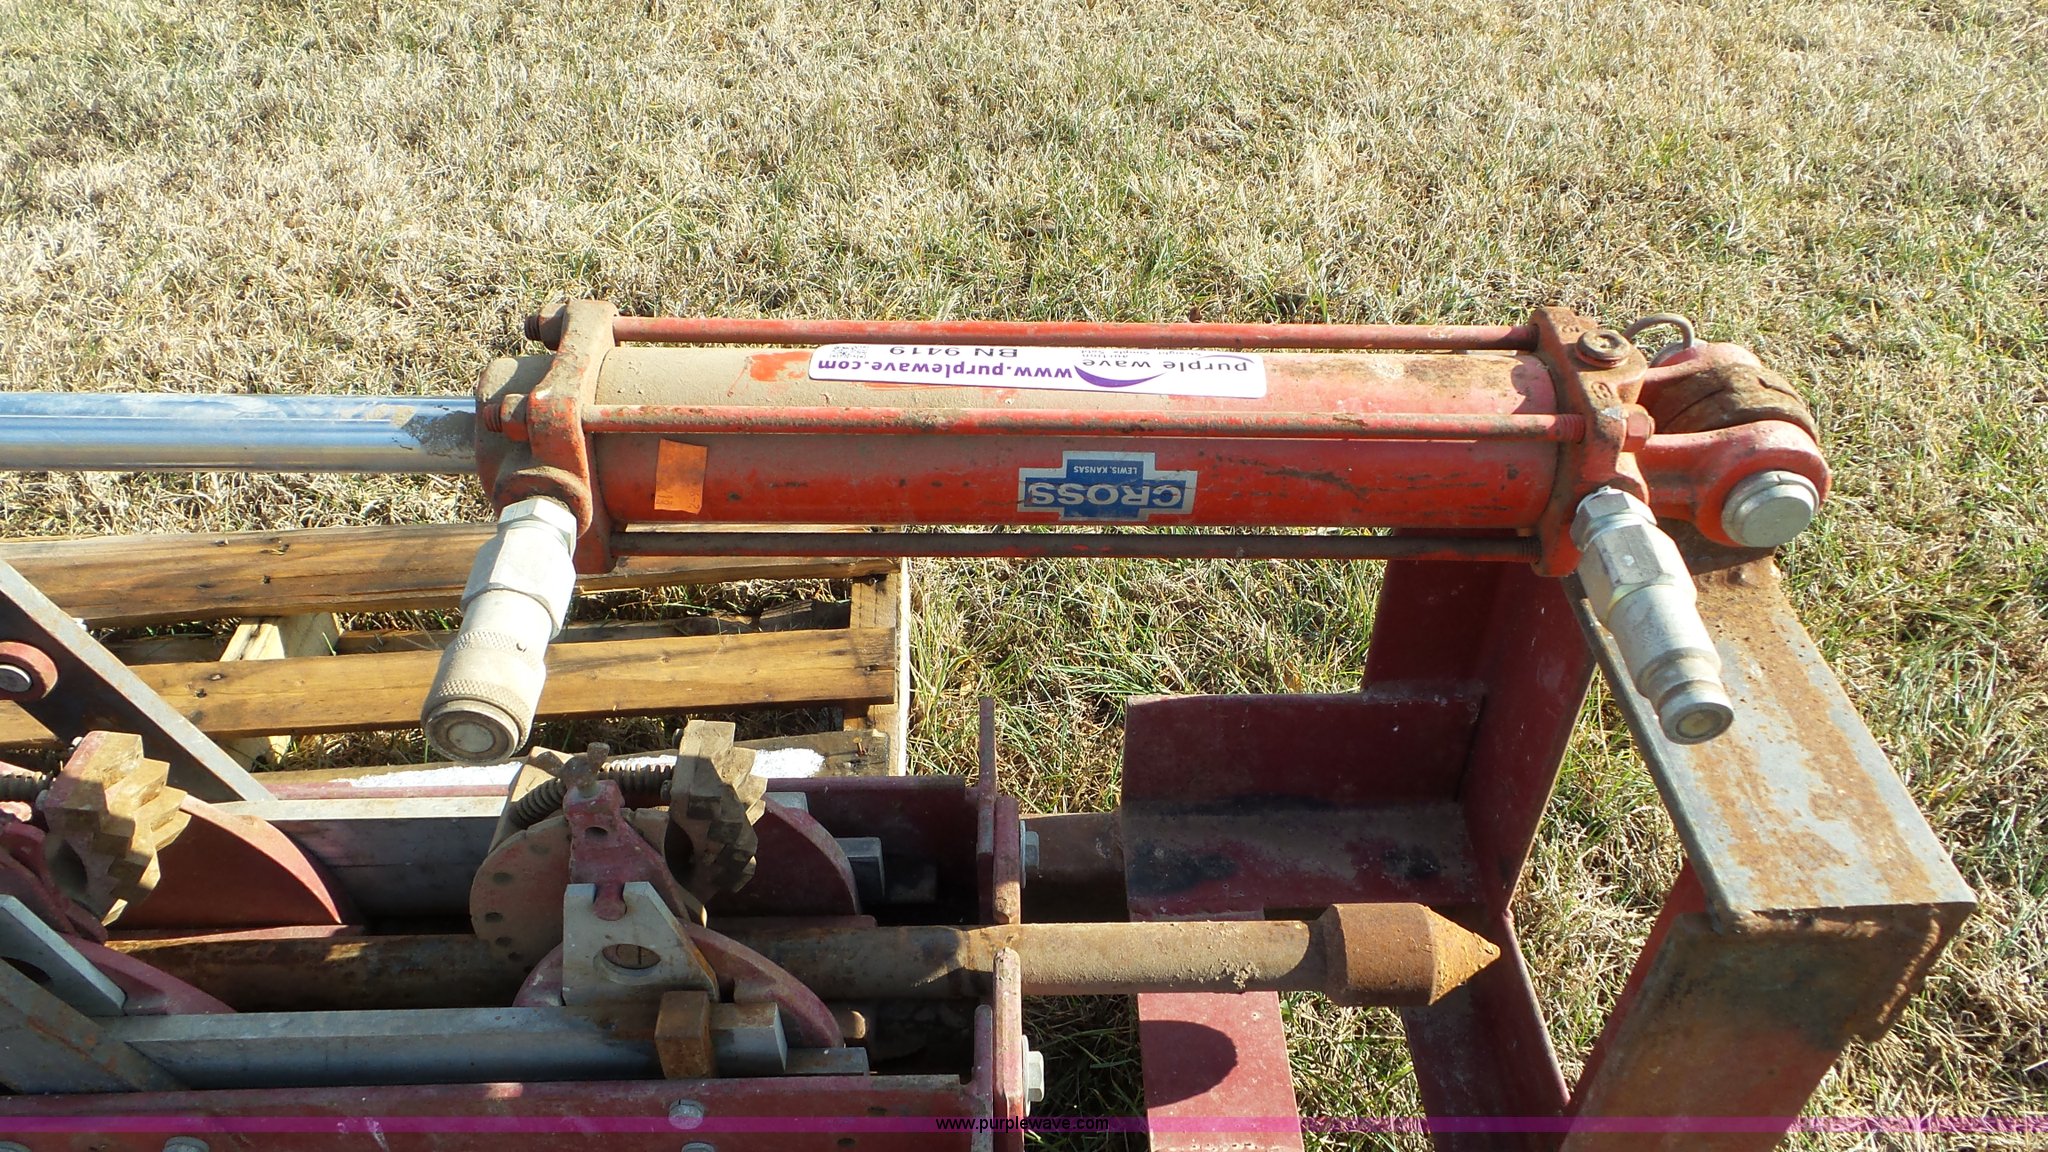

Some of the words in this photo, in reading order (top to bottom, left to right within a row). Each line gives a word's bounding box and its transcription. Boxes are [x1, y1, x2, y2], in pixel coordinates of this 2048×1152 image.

[888, 346, 961, 357] 9419
[974, 348, 1018, 358] BN
[817, 359, 1073, 379] www.purplewave.com
[1082, 359, 1151, 368] wave
[1162, 360, 1248, 373] purple
[1073, 465, 1109, 474] KANSAS
[1027, 482, 1183, 507] CROSS
